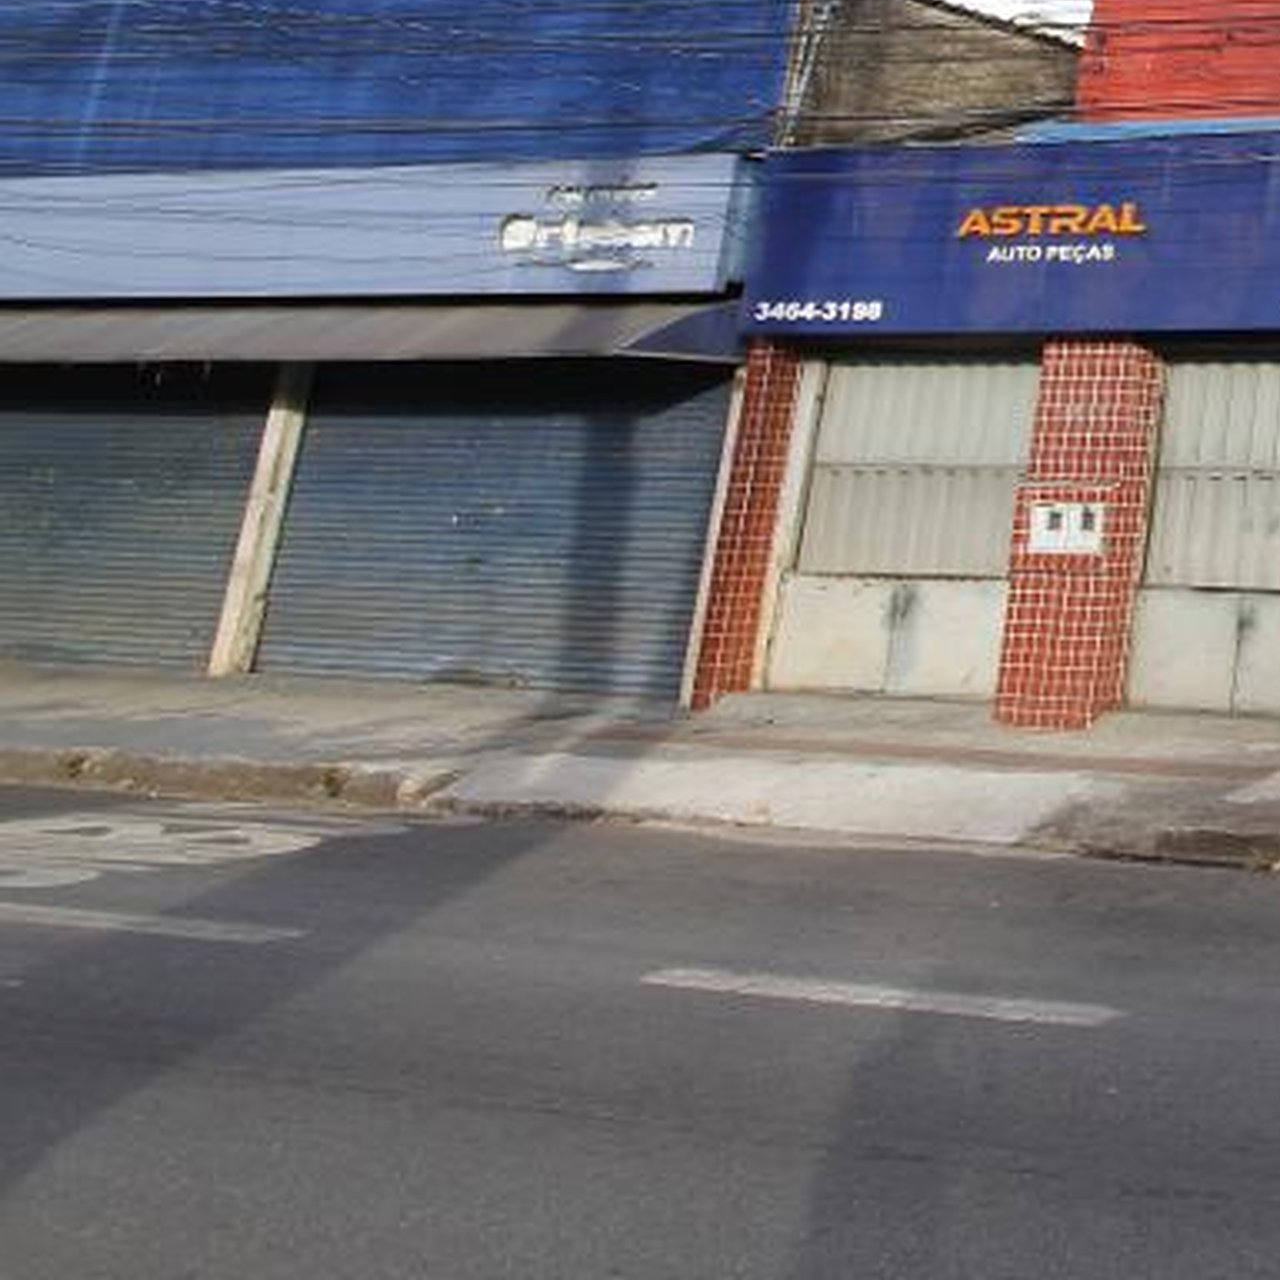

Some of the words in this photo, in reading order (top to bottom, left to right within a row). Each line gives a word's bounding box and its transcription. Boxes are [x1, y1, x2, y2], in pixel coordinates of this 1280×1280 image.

[958, 202, 1147, 238] ASTRAL
[986, 245, 1041, 262] AUTO
[1045, 244, 1115, 264] PEÇAS
